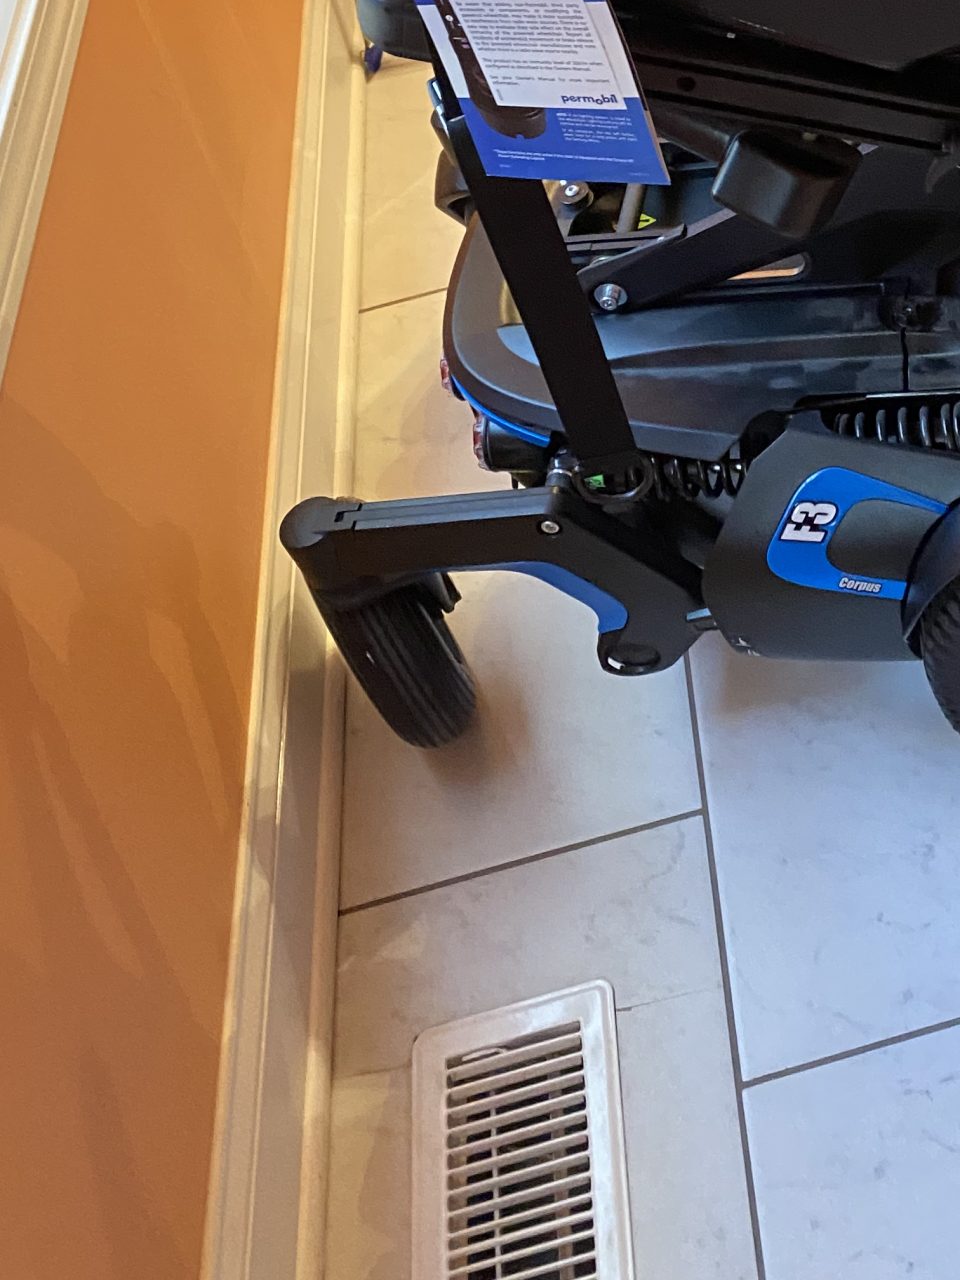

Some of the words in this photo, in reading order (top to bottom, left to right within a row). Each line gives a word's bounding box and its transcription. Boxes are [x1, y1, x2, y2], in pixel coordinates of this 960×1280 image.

[560, 93, 618, 106] permobil
[780, 501, 837, 543] F3
[838, 577, 883, 593] Corpus
